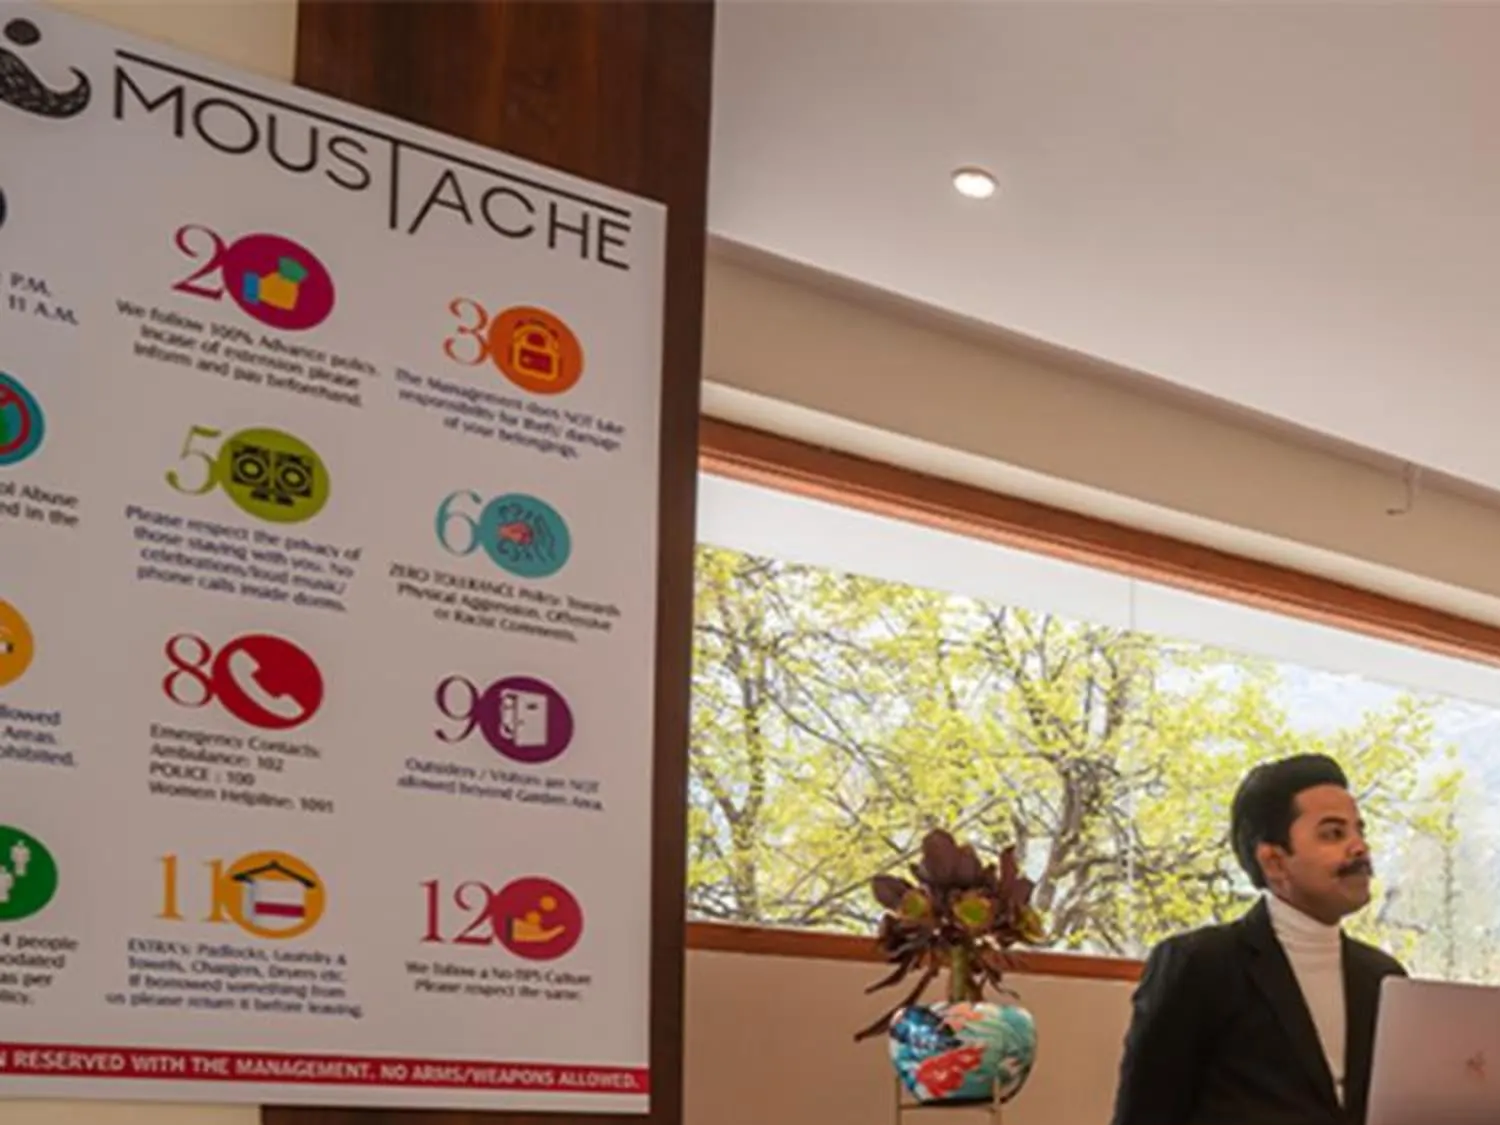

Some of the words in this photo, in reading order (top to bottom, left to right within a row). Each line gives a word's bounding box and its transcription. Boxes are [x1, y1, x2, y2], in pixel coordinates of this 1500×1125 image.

[112, 50, 633, 272] MOUSTACHE
[172, 223, 226, 300] 2
[10, 271, 52, 298] P.M.
[9, 294, 26, 312] 11
[34, 301, 79, 326] A.M.
[116, 299, 145, 317] We
[150, 307, 203, 332] follow
[259, 335, 326, 362] Advance
[442, 297, 492, 366] 3
[197, 359, 229, 376] and
[234, 366, 262, 384] pay
[200, 341, 221, 355] of
[224, 347, 303, 375] extension
[308, 366, 360, 388] please
[395, 368, 422, 385] The
[427, 377, 523, 410] Management
[526, 402, 560, 420] does
[564, 411, 593, 427] NOT
[597, 417, 625, 434] take
[398, 389, 495, 421] responsibility
[499, 411, 519, 426] for
[566, 428, 622, 452] damage
[443, 417, 459, 429] of
[463, 422, 493, 438] your
[165, 425, 220, 497] 5
[19, 484, 79, 509] Abuse
[25, 504, 45, 522] in
[48, 509, 79, 527] the
[434, 488, 484, 557] 6
[126, 504, 183, 527] Please
[186, 519, 249, 541] respect
[253, 529, 280, 545] the
[285, 537, 339, 558] privacy
[343, 547, 362, 561] of
[133, 525, 183, 545] those
[188, 537, 247, 561] staying
[251, 549, 288, 565] with
[329, 561, 355, 577] No
[137, 566, 195, 585] phone
[198, 576, 235, 593] calls
[240, 583, 290, 601] inside
[389, 562, 429, 582] ZERO
[433, 569, 514, 598] TOLERANCE
[566, 595, 621, 617] Towards
[397, 581, 456, 603] Physical
[545, 609, 612, 633] Offensive
[433, 608, 449, 620] or
[454, 611, 496, 628] Racist
[161, 633, 215, 708] 8
[0, 704, 61, 729] llowed
[434, 675, 482, 745] 9
[5, 725, 57, 745] Areas.
[150, 724, 243, 748] Emergency
[0, 743, 80, 770] ohibited.
[151, 743, 250, 767] Ambulance:
[257, 755, 285, 772] 102
[150, 761, 208, 780] POLICE
[226, 771, 255, 786] 100
[405, 757, 476, 779] Outsiders
[490, 769, 541, 785] Visitors
[545, 778, 565, 788] are
[570, 779, 600, 794] NOT
[149, 781, 216, 799] Women
[220, 789, 295, 810] Helpline:
[300, 797, 334, 814] 1091
[397, 776, 456, 794] allowed
[459, 782, 514, 800] beyond
[515, 789, 566, 804] Garden
[419, 878, 497, 947] 12
[1, 931, 10, 948] 4
[17, 935, 80, 953] people
[0, 951, 65, 970] odated
[273, 949, 332, 965] Laundry
[337, 952, 348, 966] &
[405, 960, 429, 974] We
[433, 962, 476, 978] follow
[480, 968, 488, 979] a
[545, 968, 592, 985] Culture
[22, 972, 53, 988] per
[145, 975, 222, 993] borrowed
[226, 981, 307, 999] something
[311, 984, 345, 998] from
[414, 978, 461, 993] Please
[464, 982, 514, 998] respect
[518, 985, 541, 997] the
[106, 993, 126, 1005] us
[130, 992, 183, 1008] please
[188, 995, 234, 1010] return
[240, 998, 249, 1010] it
[254, 997, 303, 1013] before
[13, 1050, 125, 1071] RESERVED
[130, 1055, 185, 1072] WITH
[190, 1056, 229, 1075] THE
[381, 1065, 407, 1080] NO
[411, 1065, 554, 1085] ARMS/WEAPONS
